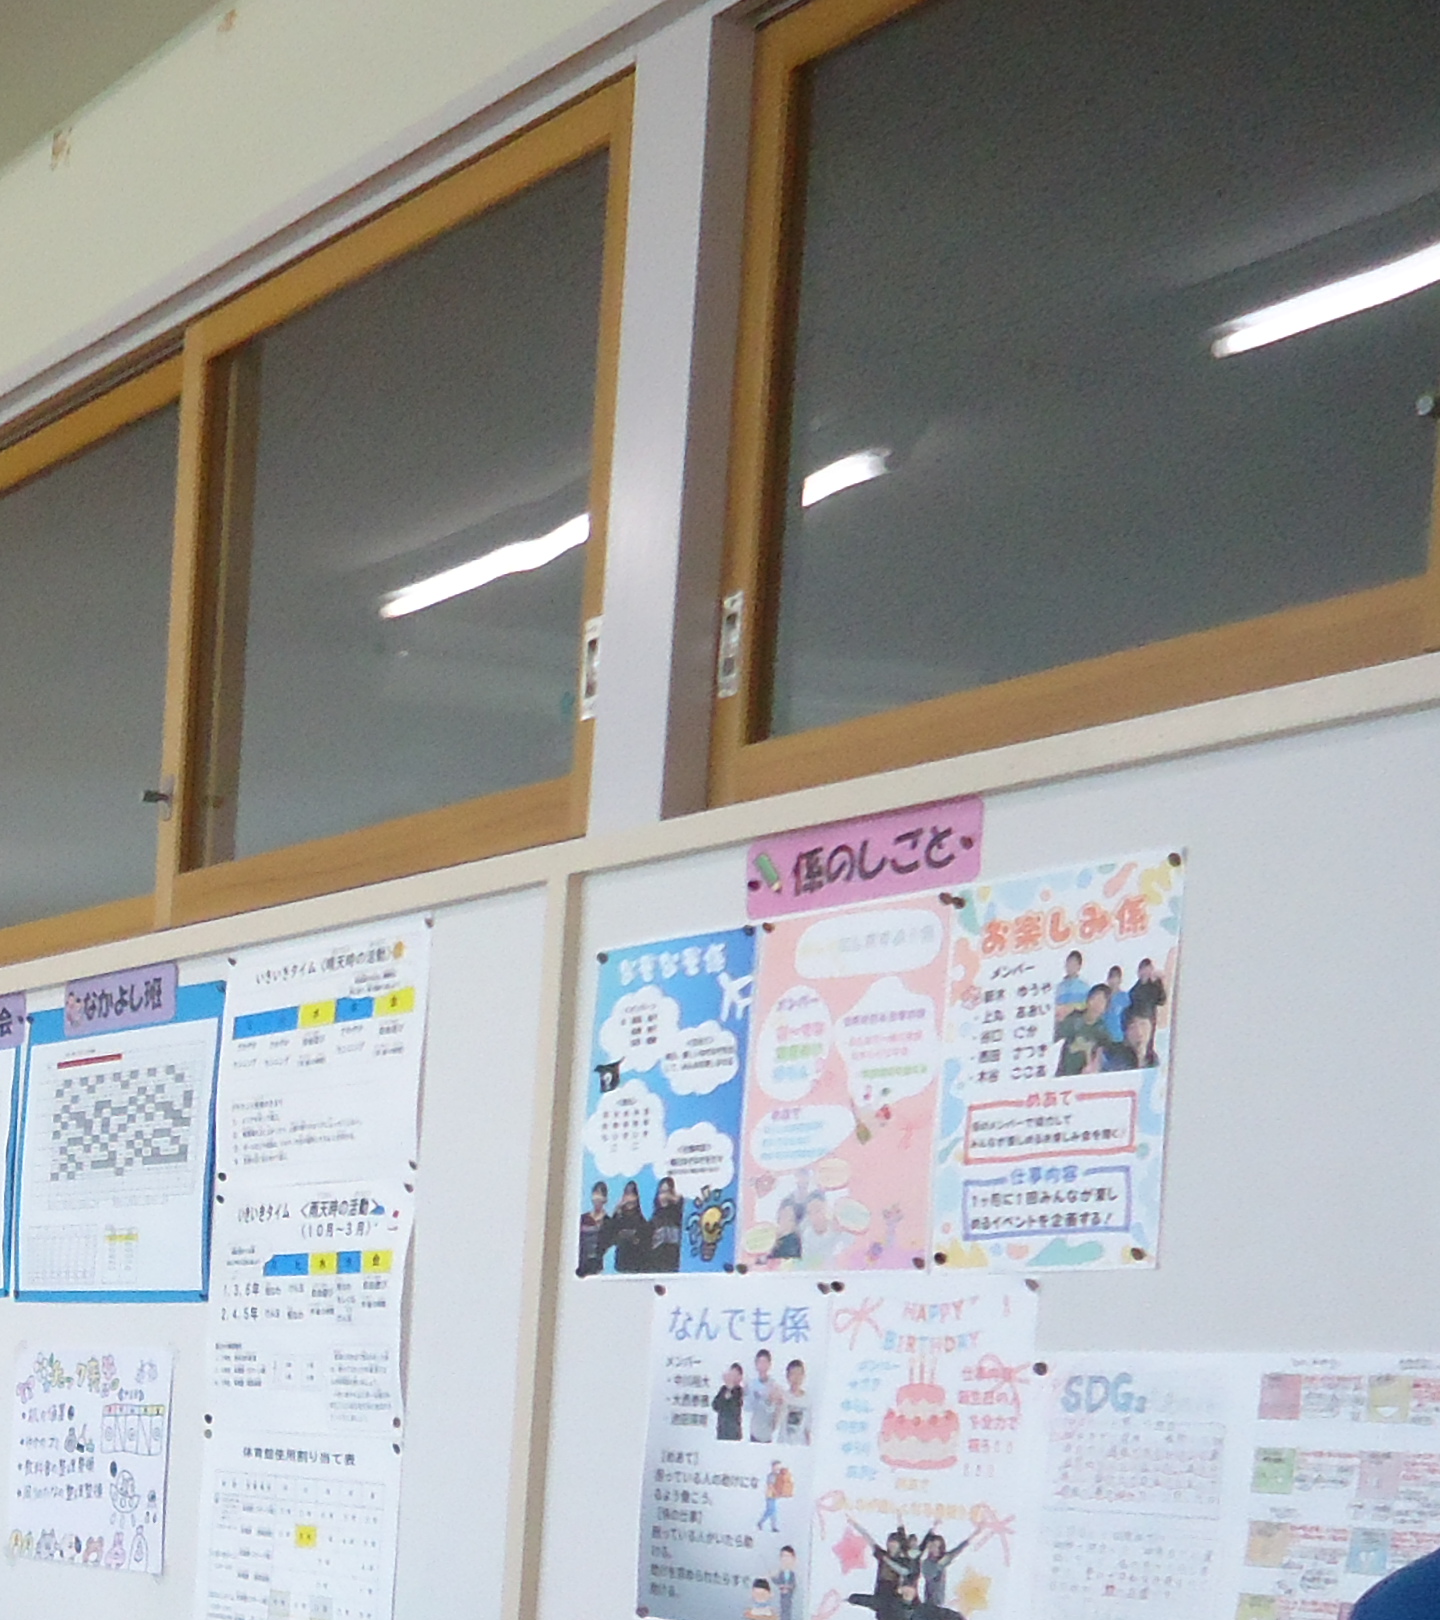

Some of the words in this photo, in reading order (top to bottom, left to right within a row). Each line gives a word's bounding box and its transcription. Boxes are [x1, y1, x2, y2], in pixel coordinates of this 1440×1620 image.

[792, 826, 956, 896] 係のしごと
[981, 894, 1150, 956] お楽しみ係
[990, 962, 1036, 980] メンバー
[83, 977, 162, 1020] なかよし班
[1024, 1089, 1074, 1108] めあて
[238, 1203, 290, 1223] いきいきタイム
[668, 1304, 811, 1344] なんでも係
[1060, 1371, 1148, 1414] SDGs
[242, 1446, 357, 1467] 体育館使用割り当て表
